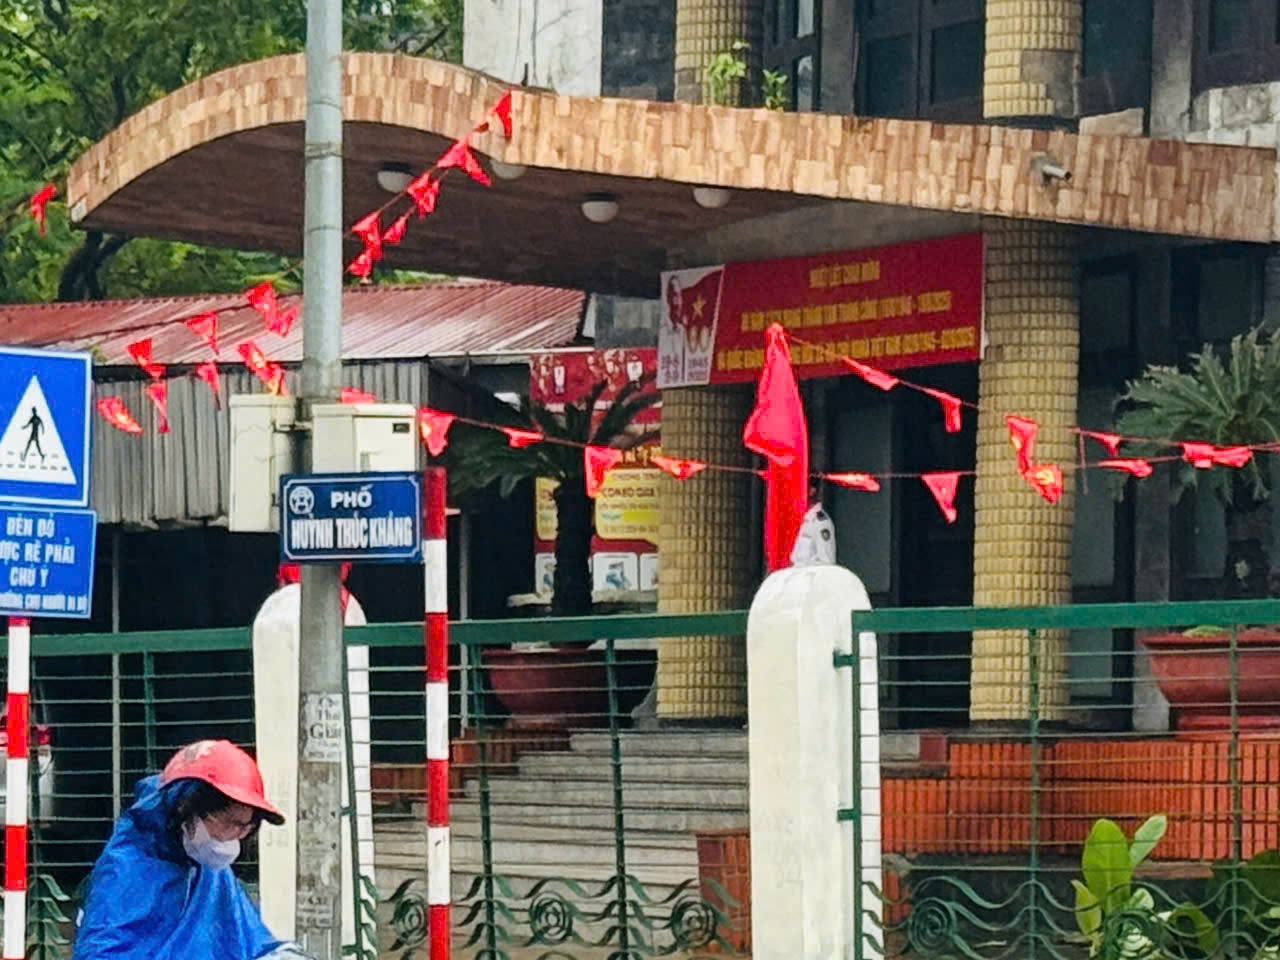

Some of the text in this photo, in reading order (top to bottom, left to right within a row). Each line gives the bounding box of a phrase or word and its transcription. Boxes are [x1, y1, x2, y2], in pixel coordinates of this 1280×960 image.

[331, 484, 373, 508] PHỐ
[291, 510, 412, 549] HUỲNH THÚC KHÁNG
[45, 537, 75, 564] PHẢI
